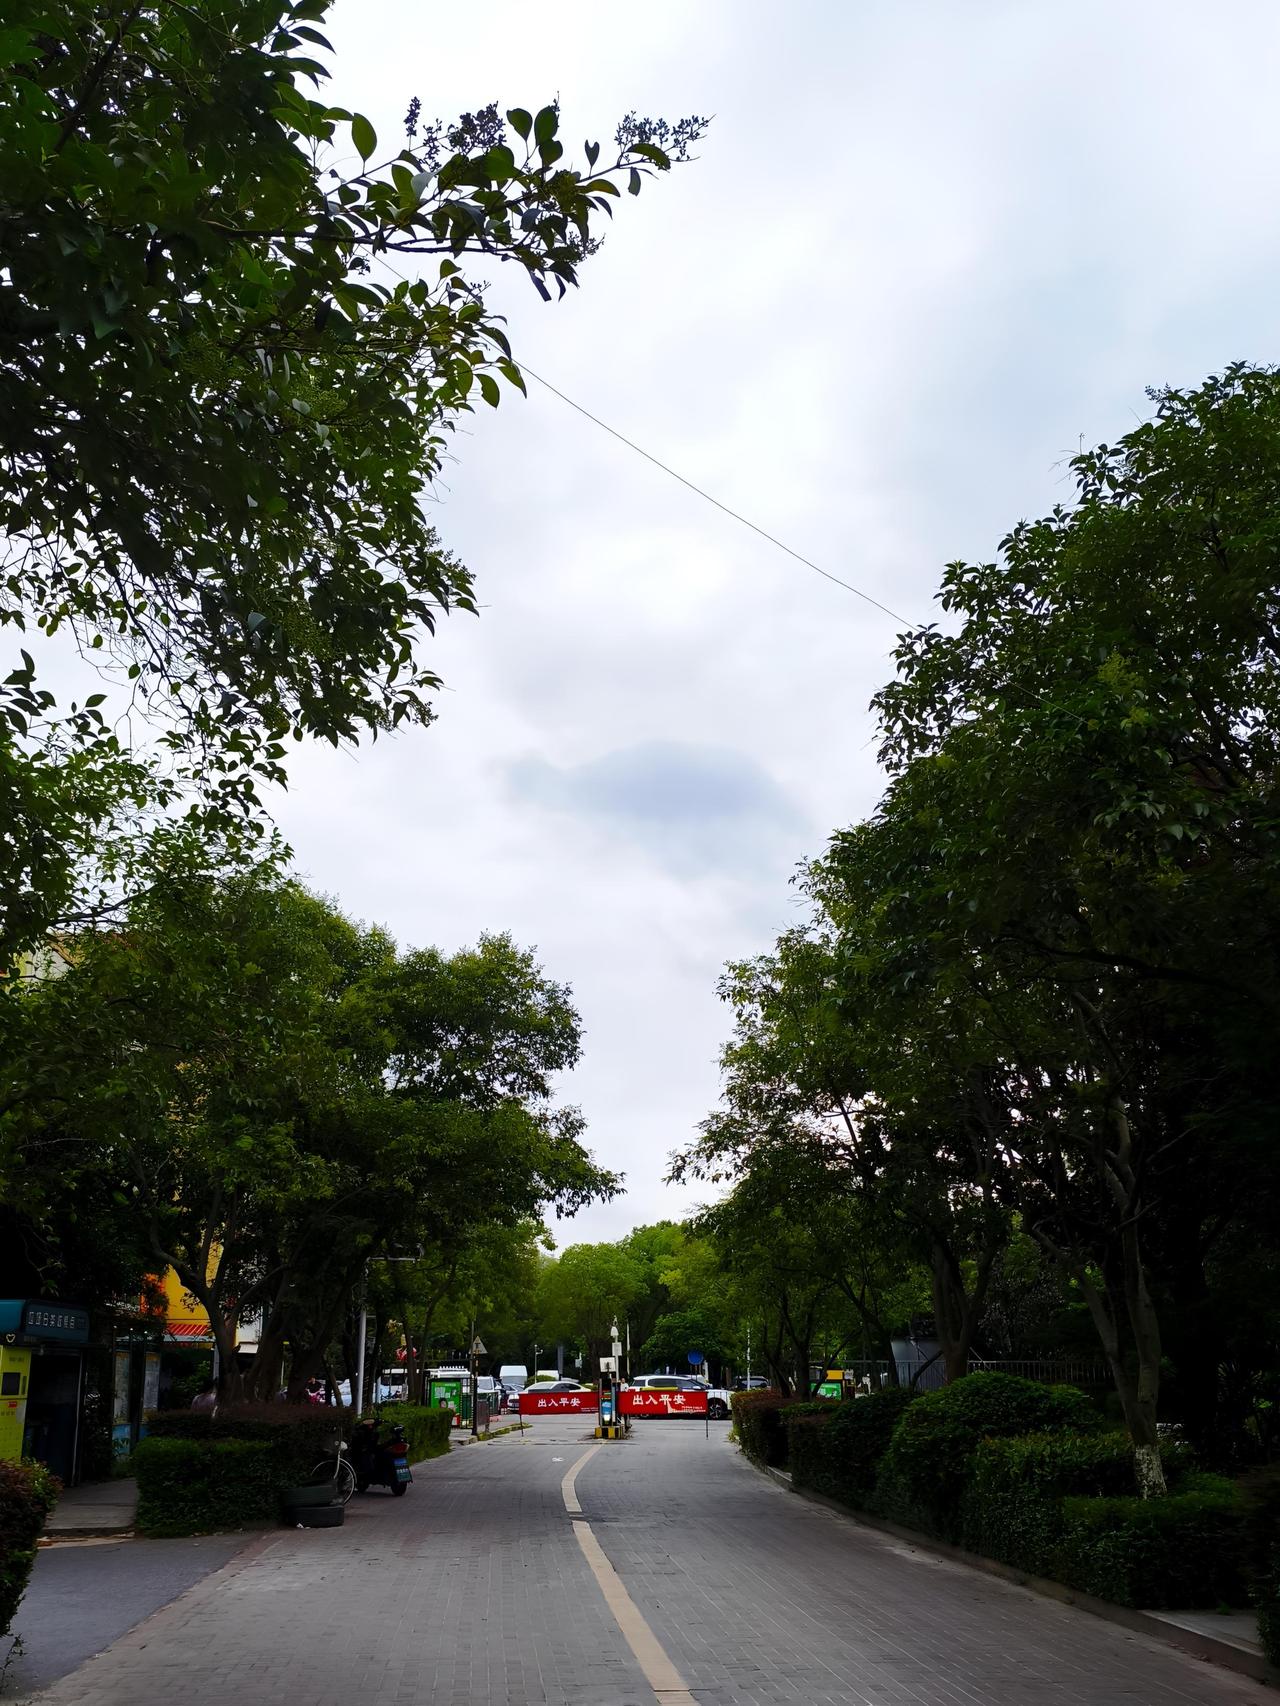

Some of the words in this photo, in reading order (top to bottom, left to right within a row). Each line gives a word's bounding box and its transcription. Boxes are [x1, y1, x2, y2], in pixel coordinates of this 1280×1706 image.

[537, 1397, 581, 1408] 出入平安
[632, 1394, 686, 1406] 出入平安
